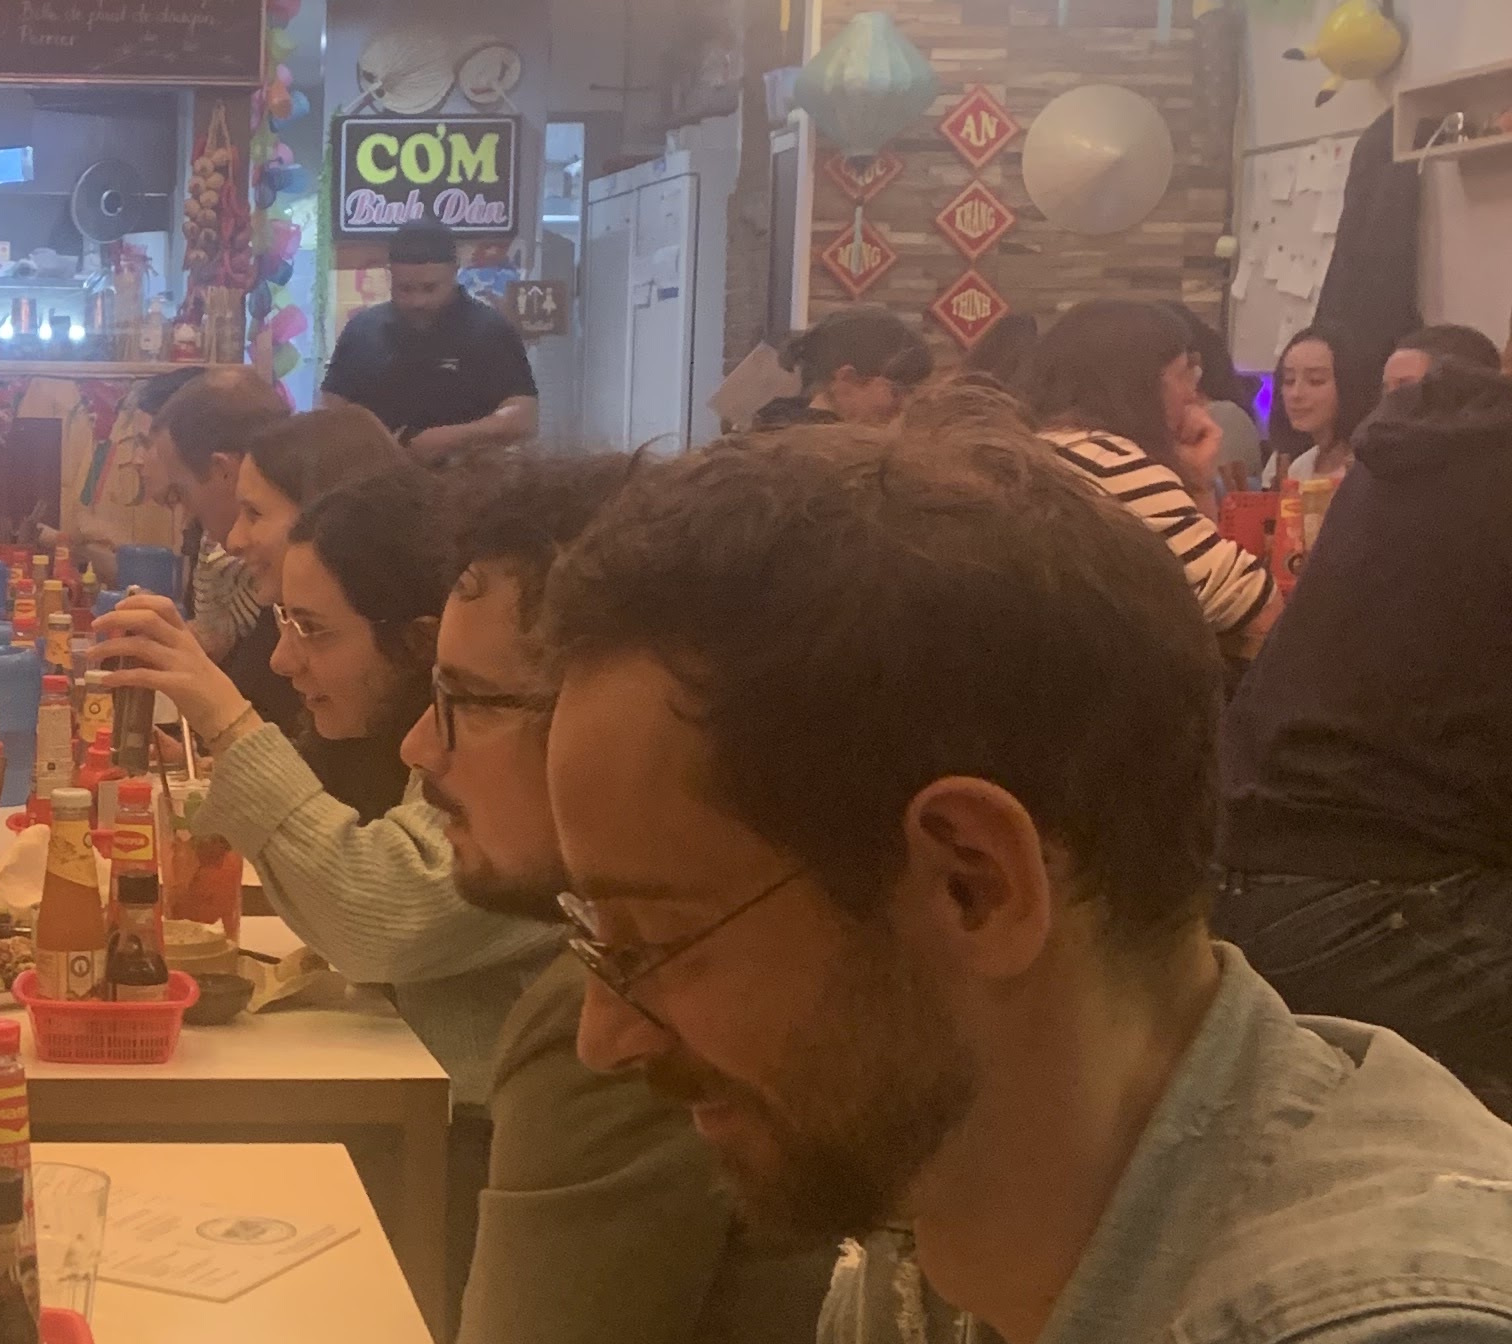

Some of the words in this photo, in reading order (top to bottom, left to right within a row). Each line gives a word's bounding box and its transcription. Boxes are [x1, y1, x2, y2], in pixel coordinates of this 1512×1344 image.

[960, 109, 1000, 148] AN
[356, 124, 500, 184] CƠM
[346, 188, 425, 224] Bình
[433, 188, 509, 224] Dân
